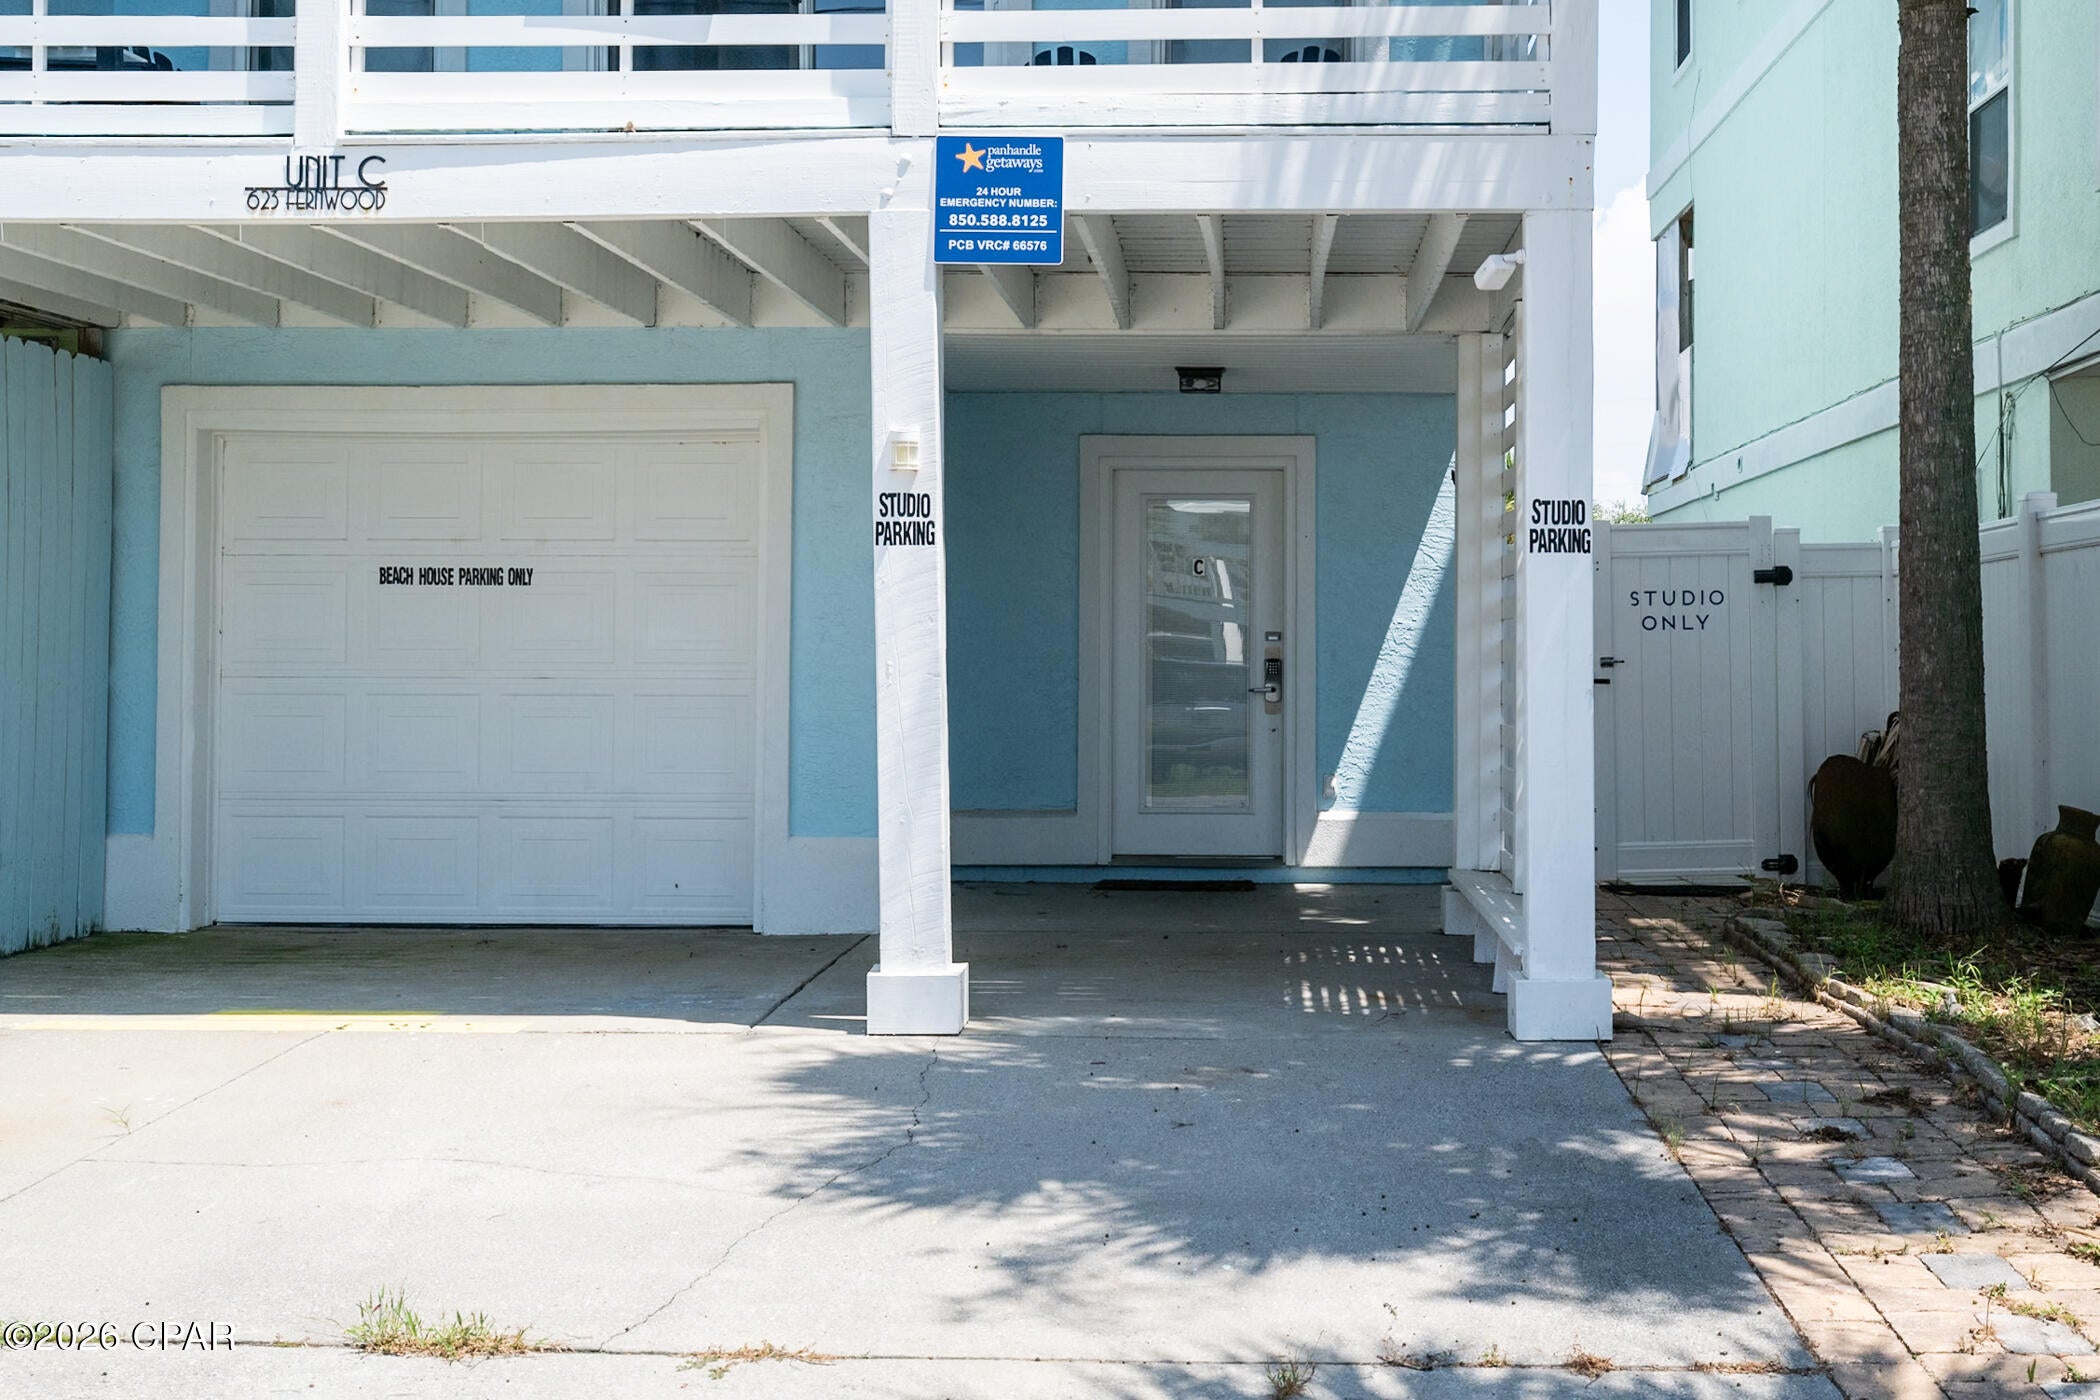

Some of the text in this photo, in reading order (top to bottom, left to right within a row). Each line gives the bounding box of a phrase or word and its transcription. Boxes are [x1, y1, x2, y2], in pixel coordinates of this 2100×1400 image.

[987, 143, 1042, 159] panhandle
[286, 155, 386, 188] UNIT C
[985, 157, 1043, 173] getaways
[246, 190, 386, 210] 623 FERNWOOD
[976, 187, 1021, 196] 24 HOUR
[940, 198, 1058, 208] EMERGENCY NUMBER:
[949, 214, 1048, 227] 850.588.8125
[948, 240, 1048, 251] PCB VRC# 66576
[879, 492, 931, 518] STUDIO
[1532, 499, 1585, 525] STUDIO
[875, 520, 936, 546] PARKING
[1529, 528, 1591, 554] PARKING
[1194, 559, 1204, 575] C
[379, 566, 534, 586] BEACH HOUSE PARKING ONLY
[1630, 590, 1725, 607] STUDIO
[1641, 614, 1710, 631] ONLY
